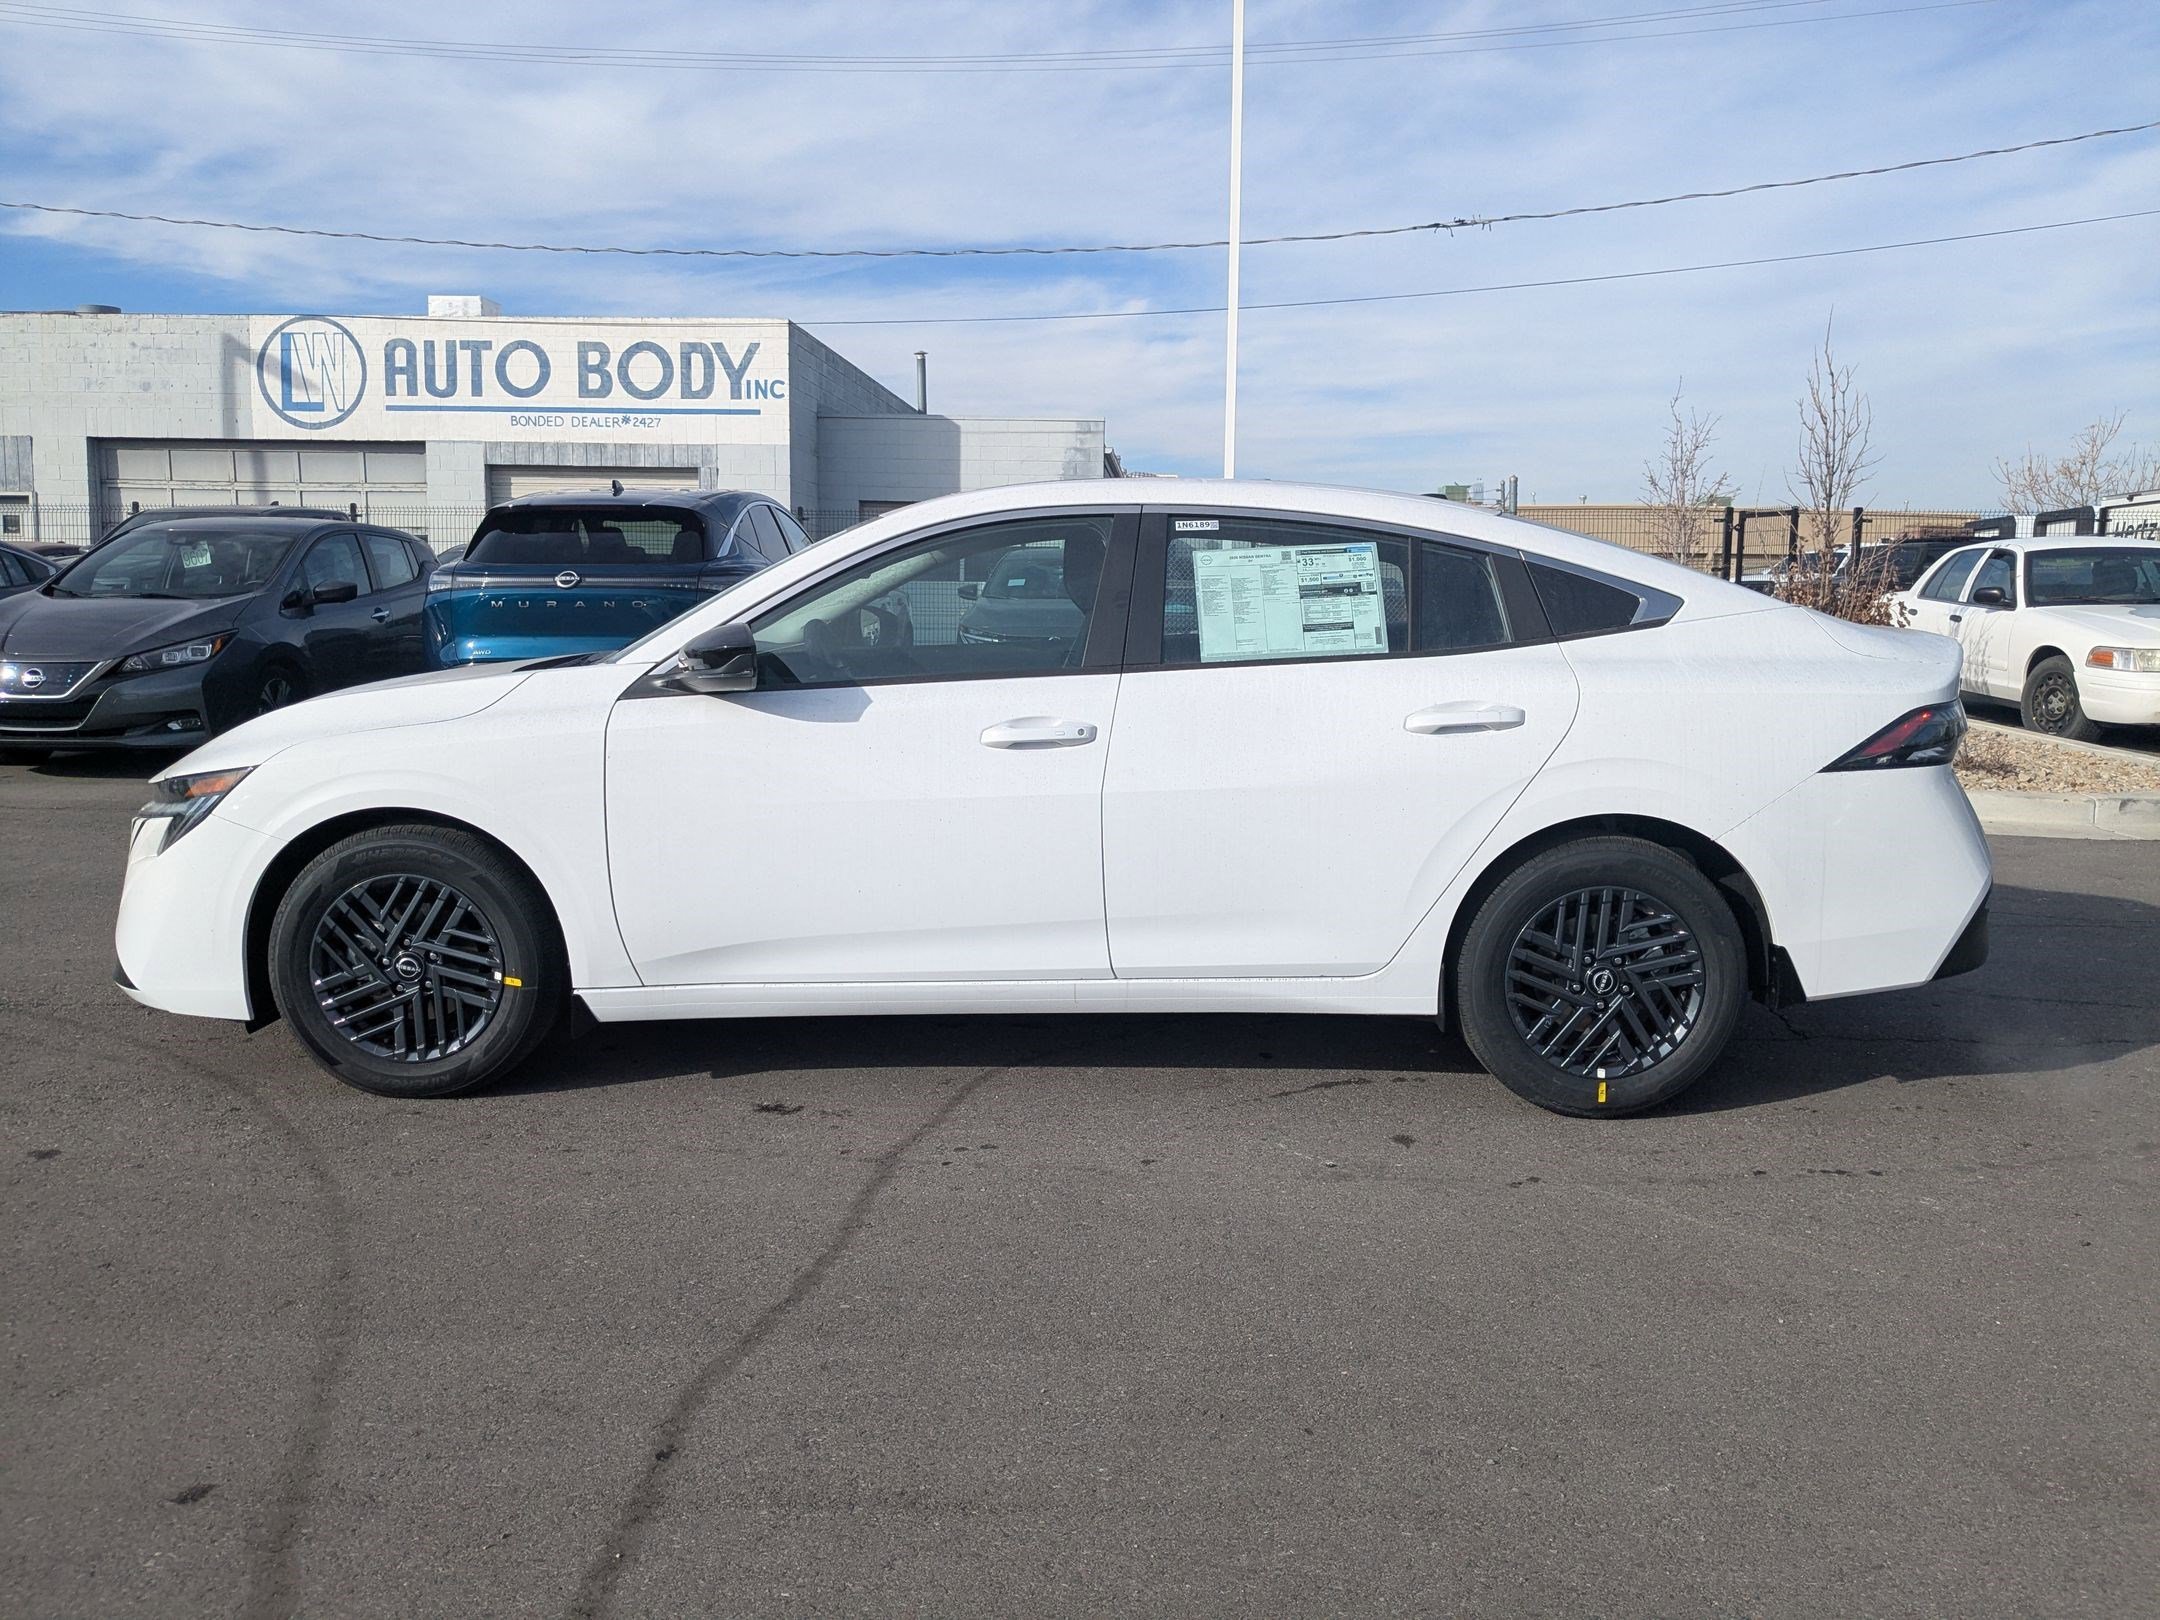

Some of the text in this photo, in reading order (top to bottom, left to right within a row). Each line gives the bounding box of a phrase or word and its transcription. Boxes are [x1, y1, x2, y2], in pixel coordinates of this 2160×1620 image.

[384, 340, 786, 400] AUTO BODY INC
[510, 415, 565, 427] BONDED
[2114, 519, 2158, 541] Hertz
[182, 548, 208, 567] 9607
[1301, 558, 1315, 567] 33
[490, 600, 645, 608] MURANO
